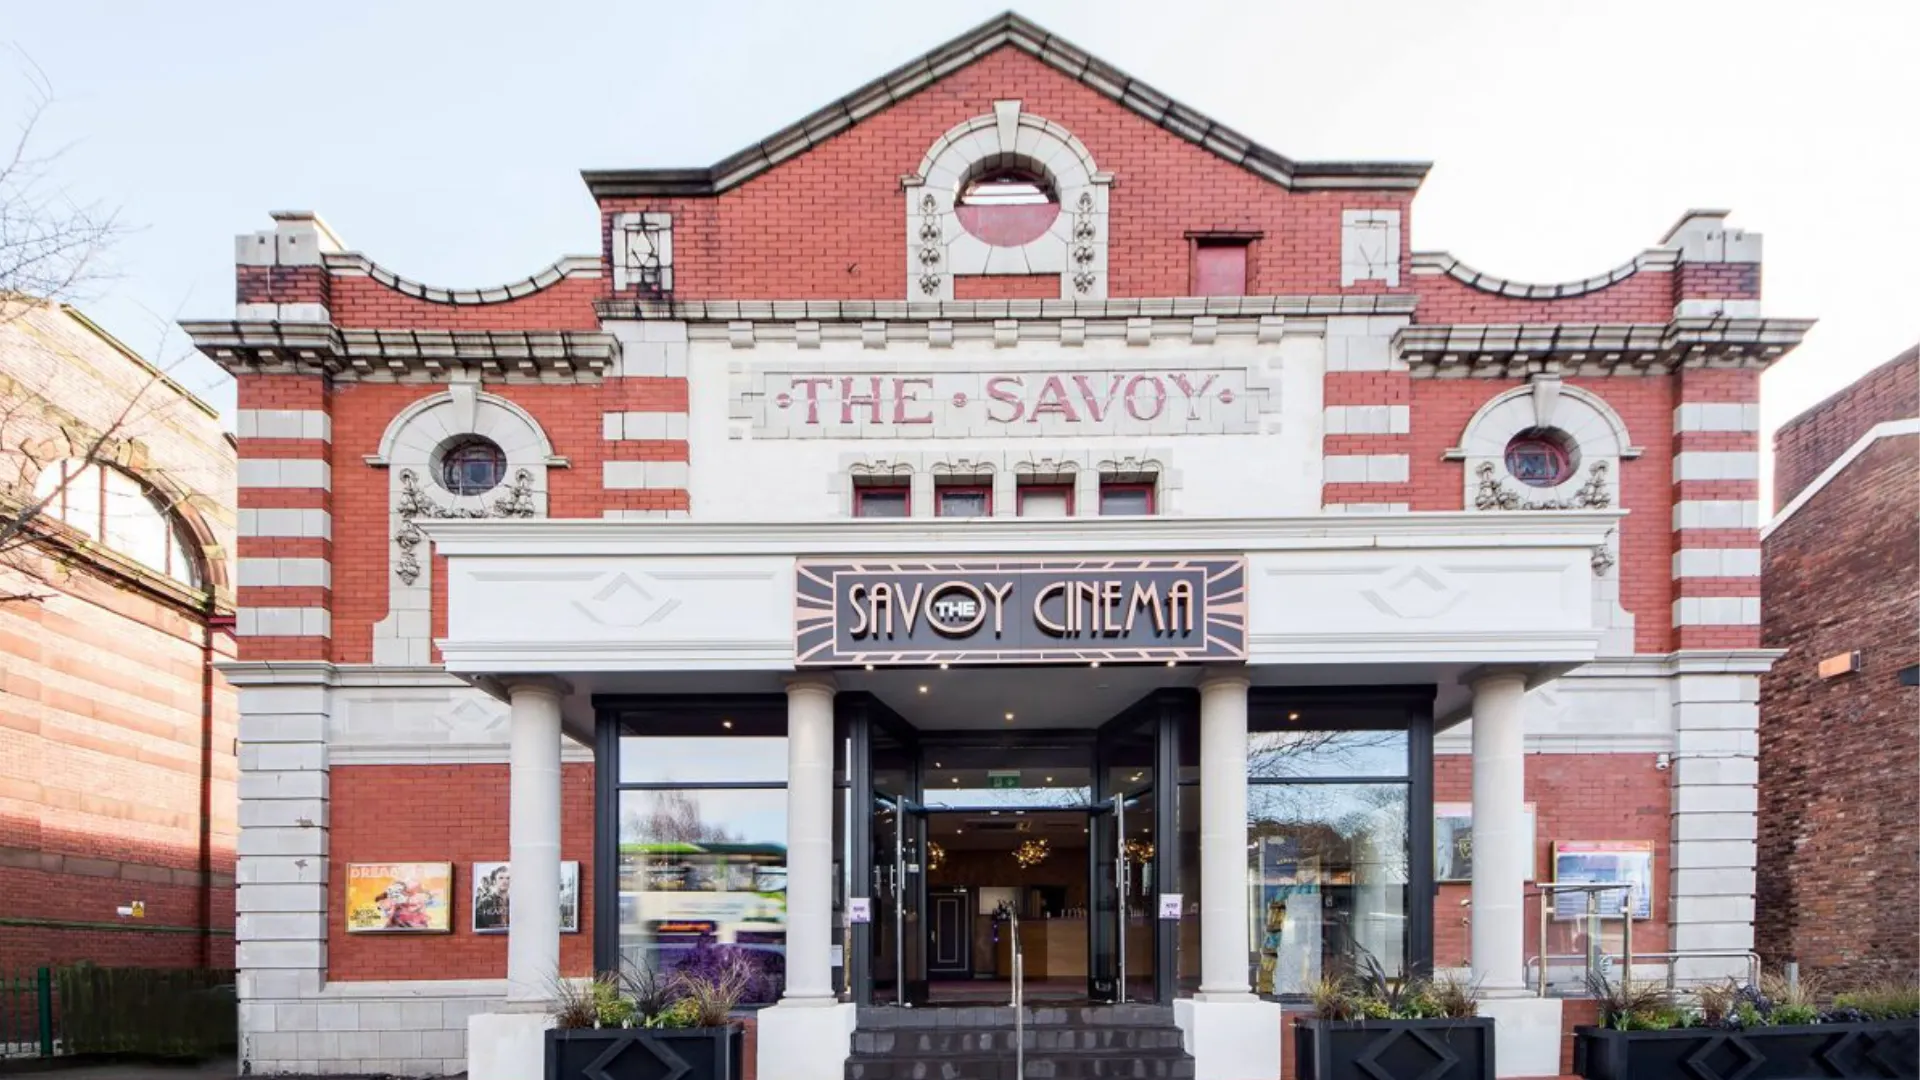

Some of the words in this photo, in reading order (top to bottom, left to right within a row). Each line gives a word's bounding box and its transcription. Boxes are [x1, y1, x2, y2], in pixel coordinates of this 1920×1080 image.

[791, 375, 934, 425] THE
[986, 373, 1220, 424] SAVOY
[848, 580, 1014, 637] SAVOY
[1033, 579, 1195, 637] CINEMA
[936, 601, 978, 619] THE
